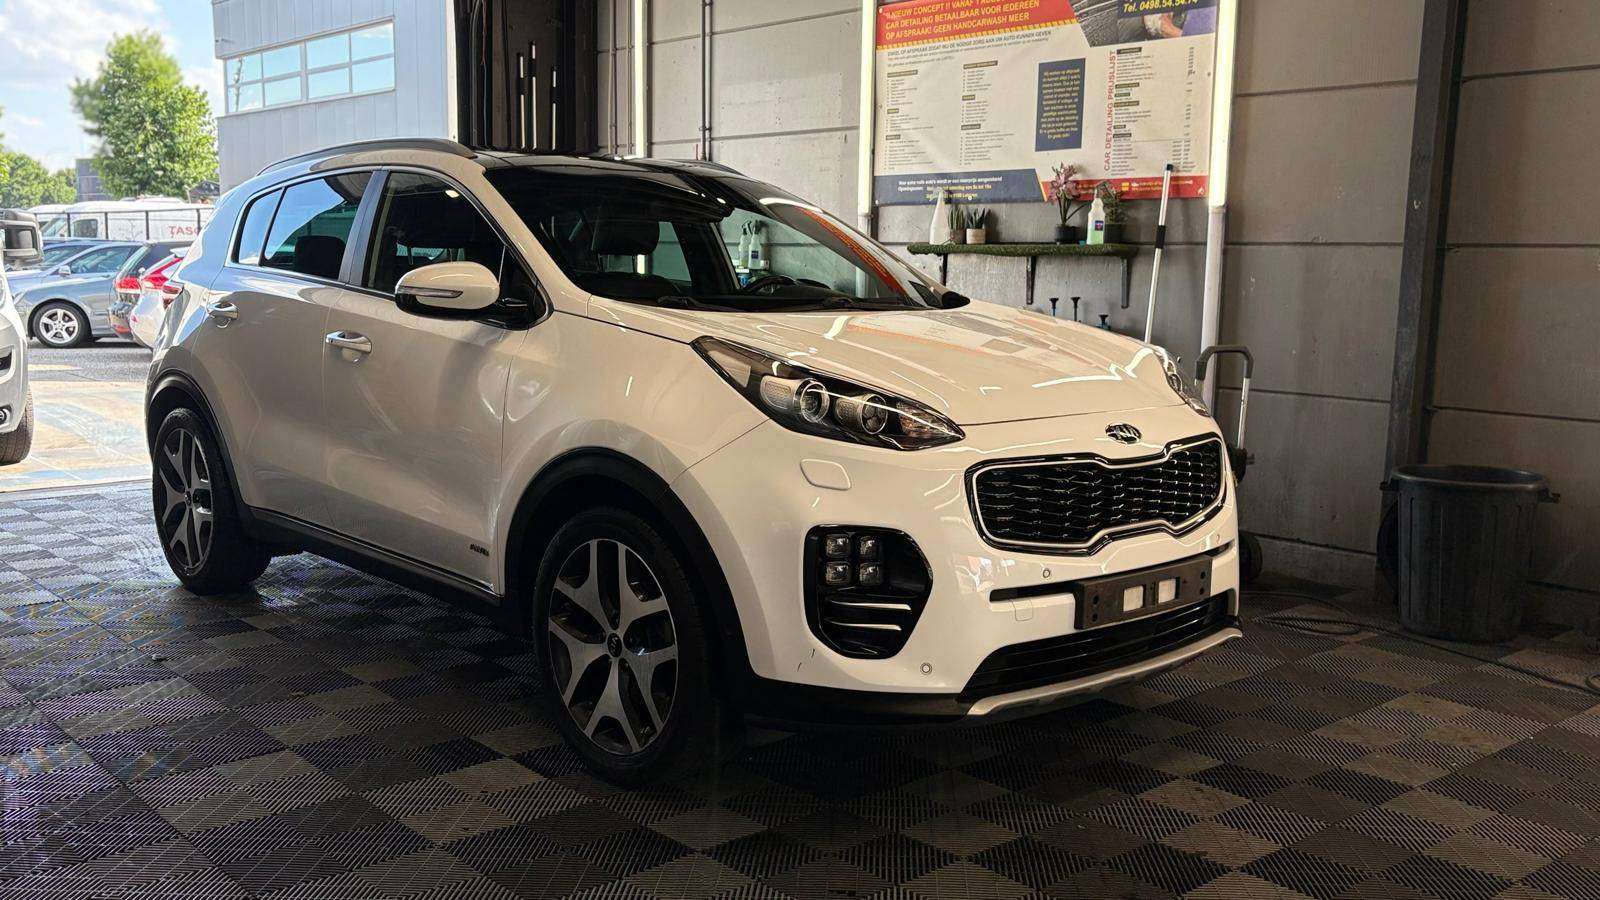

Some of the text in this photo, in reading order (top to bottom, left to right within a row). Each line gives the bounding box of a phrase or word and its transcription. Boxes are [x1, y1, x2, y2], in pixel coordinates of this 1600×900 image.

[886, 0, 1040, 30] CAR DETAILING BETAALBAAR VOOR IEDEREEN
[914, 3, 944, 15] CONCEPT
[1123, 3, 1137, 13] Tel.
[885, 12, 1030, 41] OP AFSPRAAK! GEEN HANDCARWASH MEER
[1105, 104, 1114, 149] DETAILING
